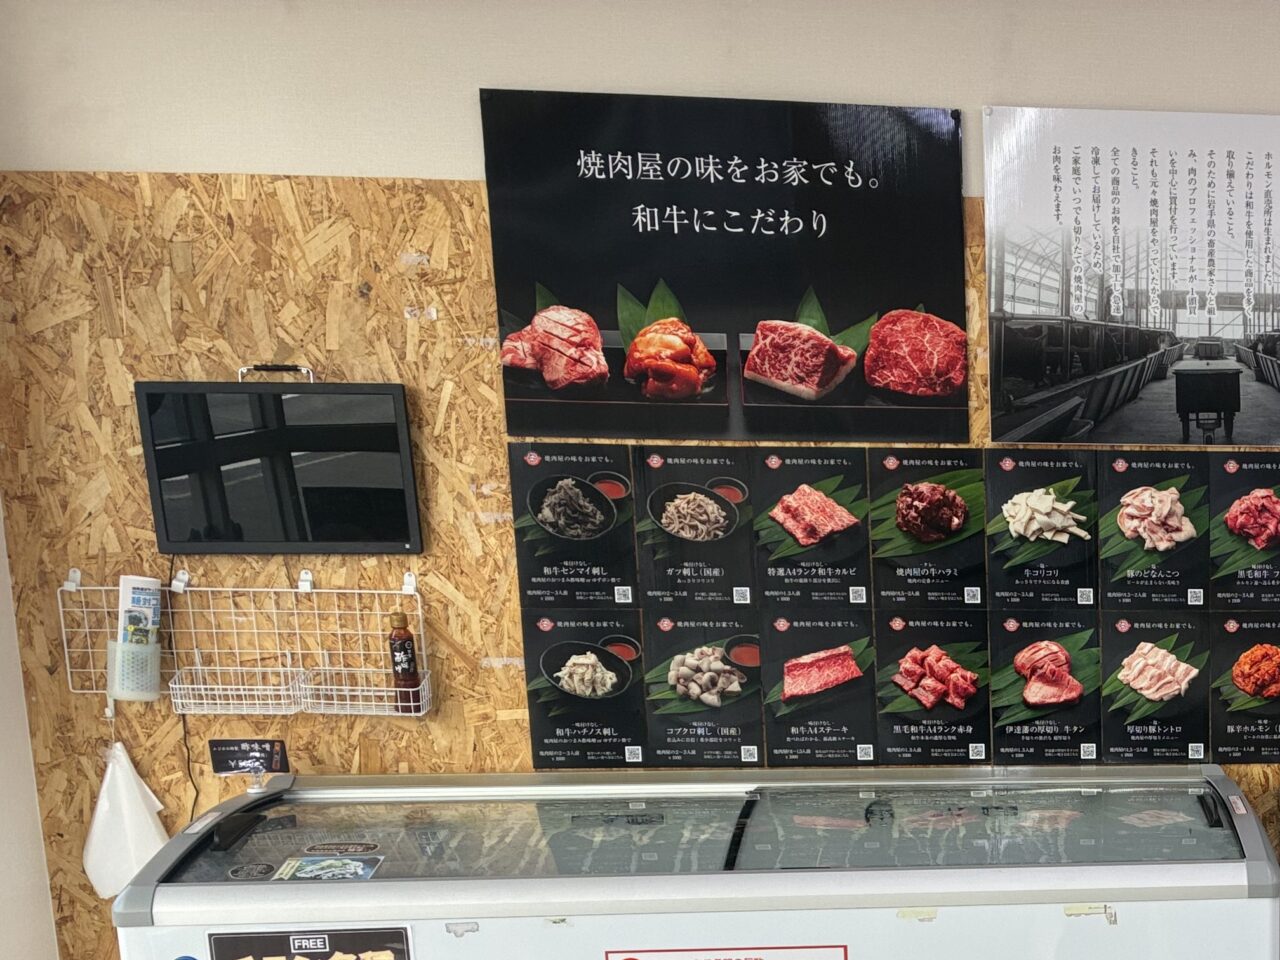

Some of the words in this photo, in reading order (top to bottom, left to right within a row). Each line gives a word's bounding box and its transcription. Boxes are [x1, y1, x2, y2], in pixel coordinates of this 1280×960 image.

[576, 150, 879, 191] 焼肉屋の味をお家でも。
[1052, 145, 1064, 226] お肉を味わえます。
[1130, 147, 1140, 190] きること。
[631, 203, 828, 239] 和牛にこだわり
[294, 939, 325, 949] FREE
